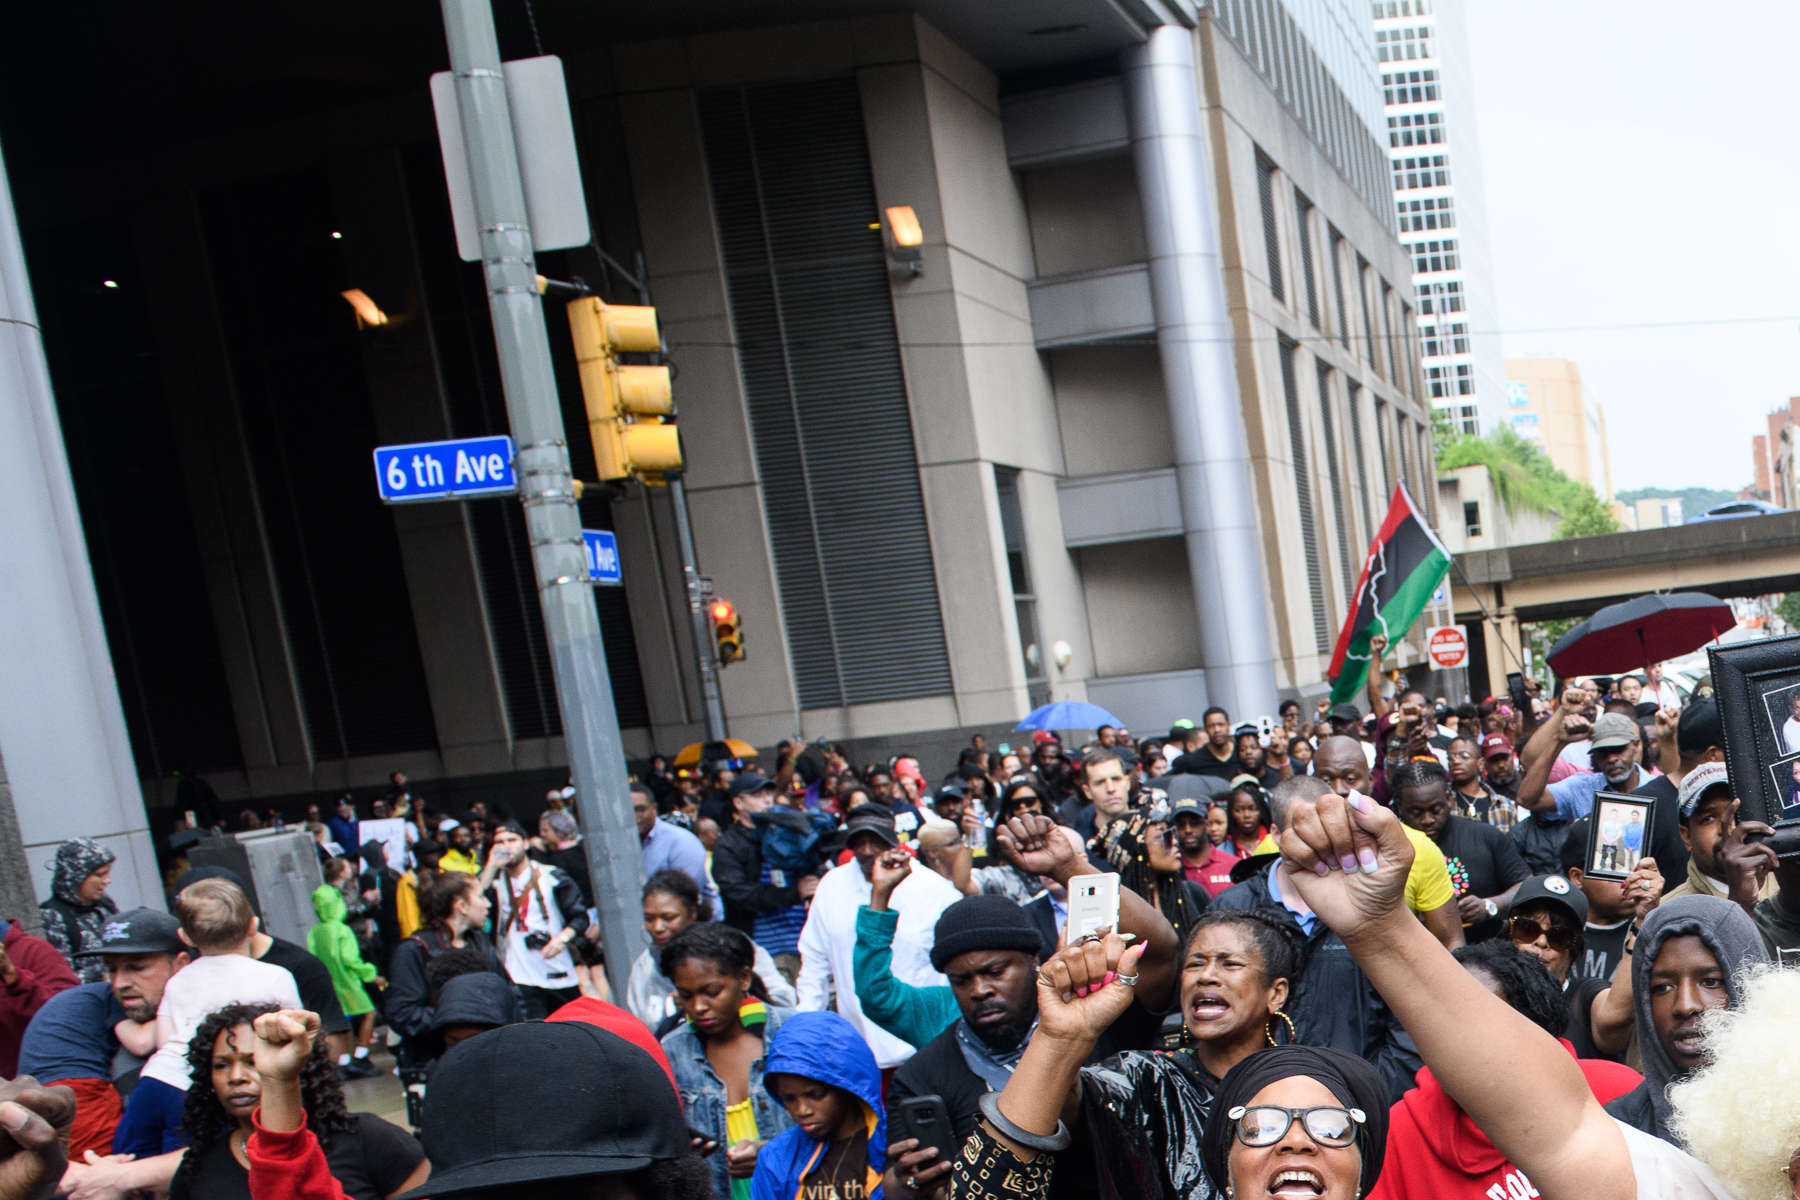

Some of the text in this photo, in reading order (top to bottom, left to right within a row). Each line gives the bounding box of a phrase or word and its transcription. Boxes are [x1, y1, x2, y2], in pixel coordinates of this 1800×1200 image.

[387, 449, 505, 491] 6 th Ave
[595, 539, 617, 572] Ave
[1433, 633, 1461, 644] DO NOT
[1438, 652, 1461, 661] ENTER
